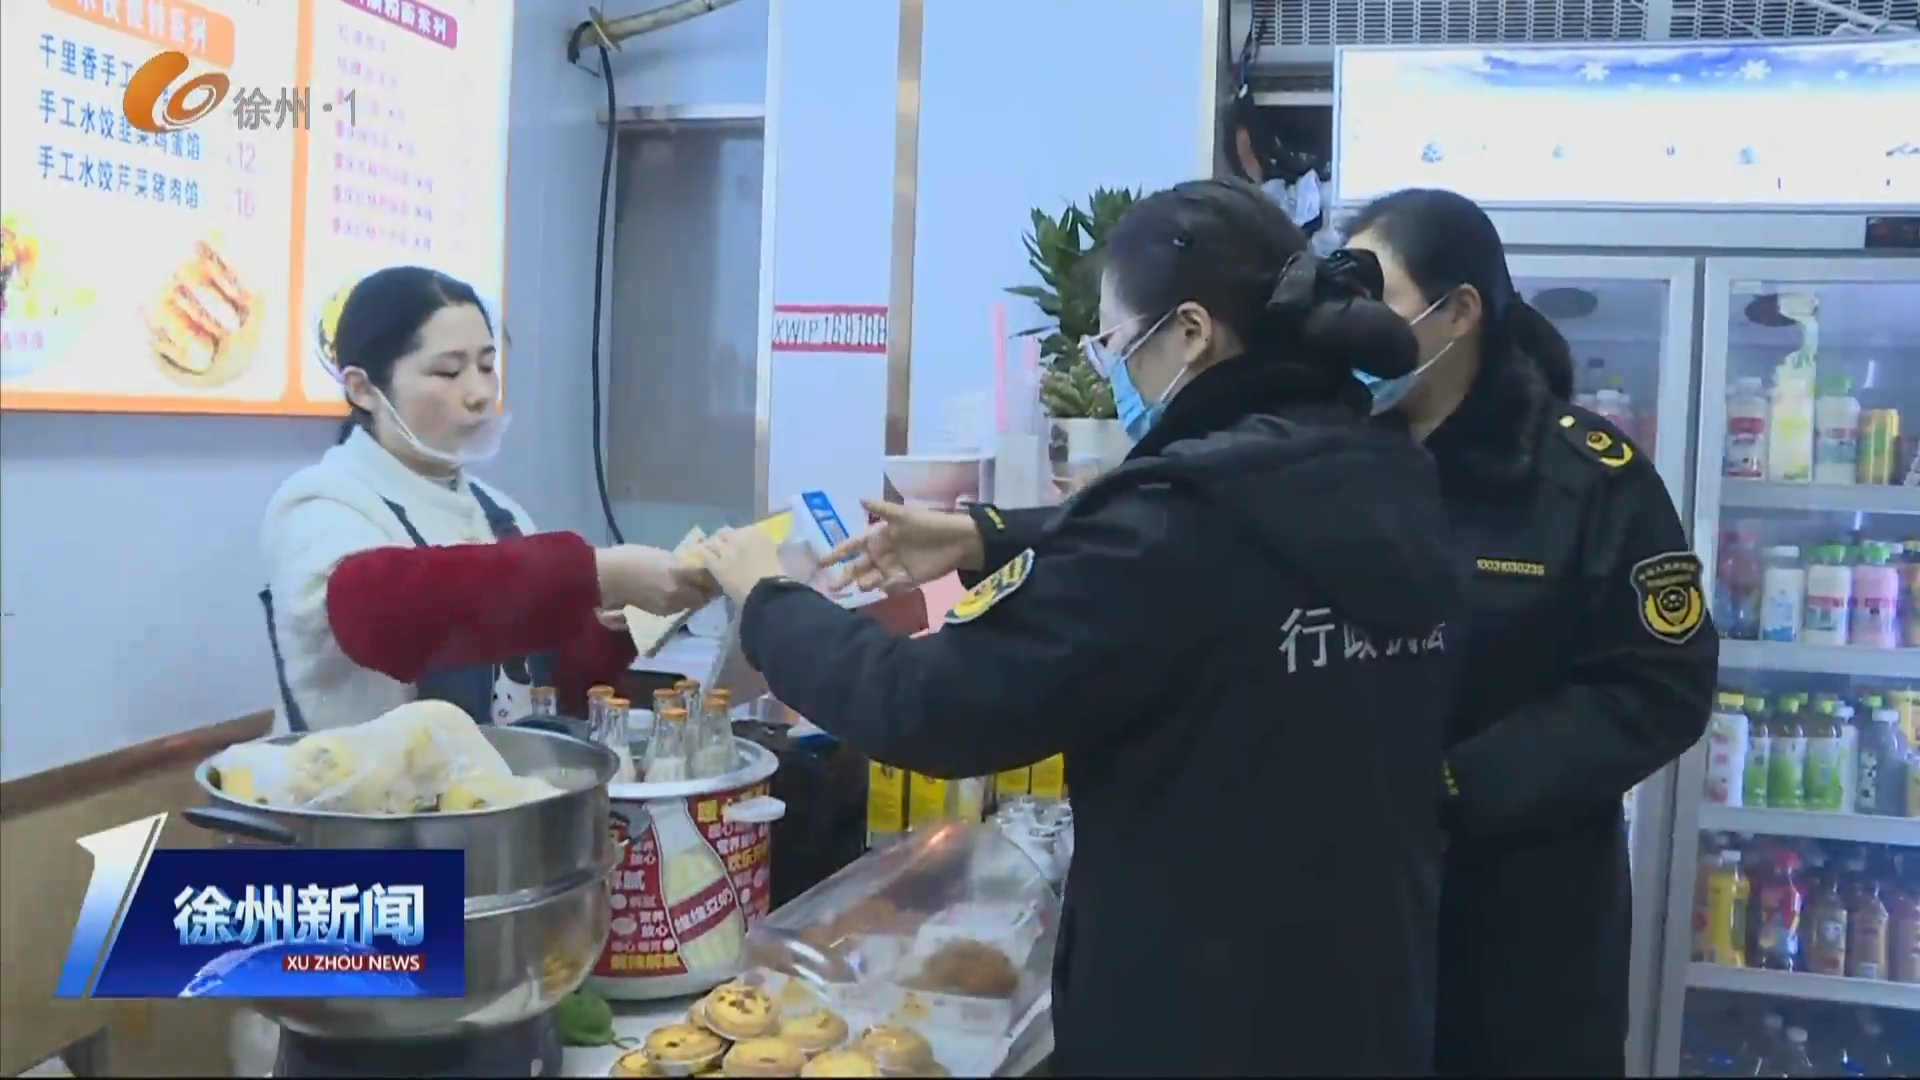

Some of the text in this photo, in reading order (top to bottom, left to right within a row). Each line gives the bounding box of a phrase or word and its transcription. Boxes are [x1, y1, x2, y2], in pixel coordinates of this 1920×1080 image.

[38, 145, 199, 209] 手工水饺芹菜猪肉馅
[1279, 607, 1446, 674] 行政
